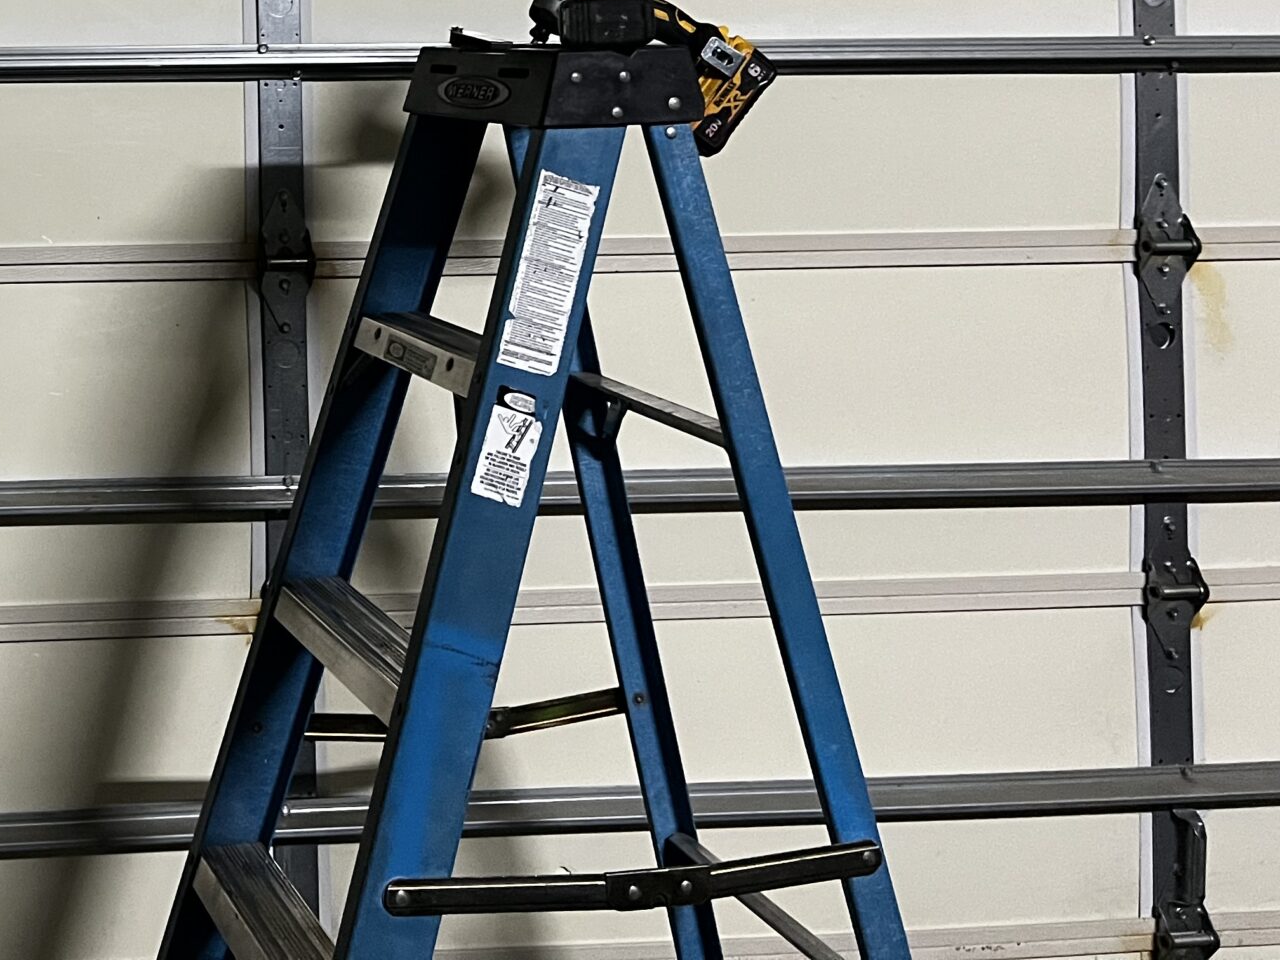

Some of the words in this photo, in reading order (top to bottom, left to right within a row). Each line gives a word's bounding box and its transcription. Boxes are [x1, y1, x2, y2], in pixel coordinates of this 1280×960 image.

[747, 63, 761, 78] 6
[447, 83, 495, 101] WERNER
[705, 119, 722, 138] 20V
